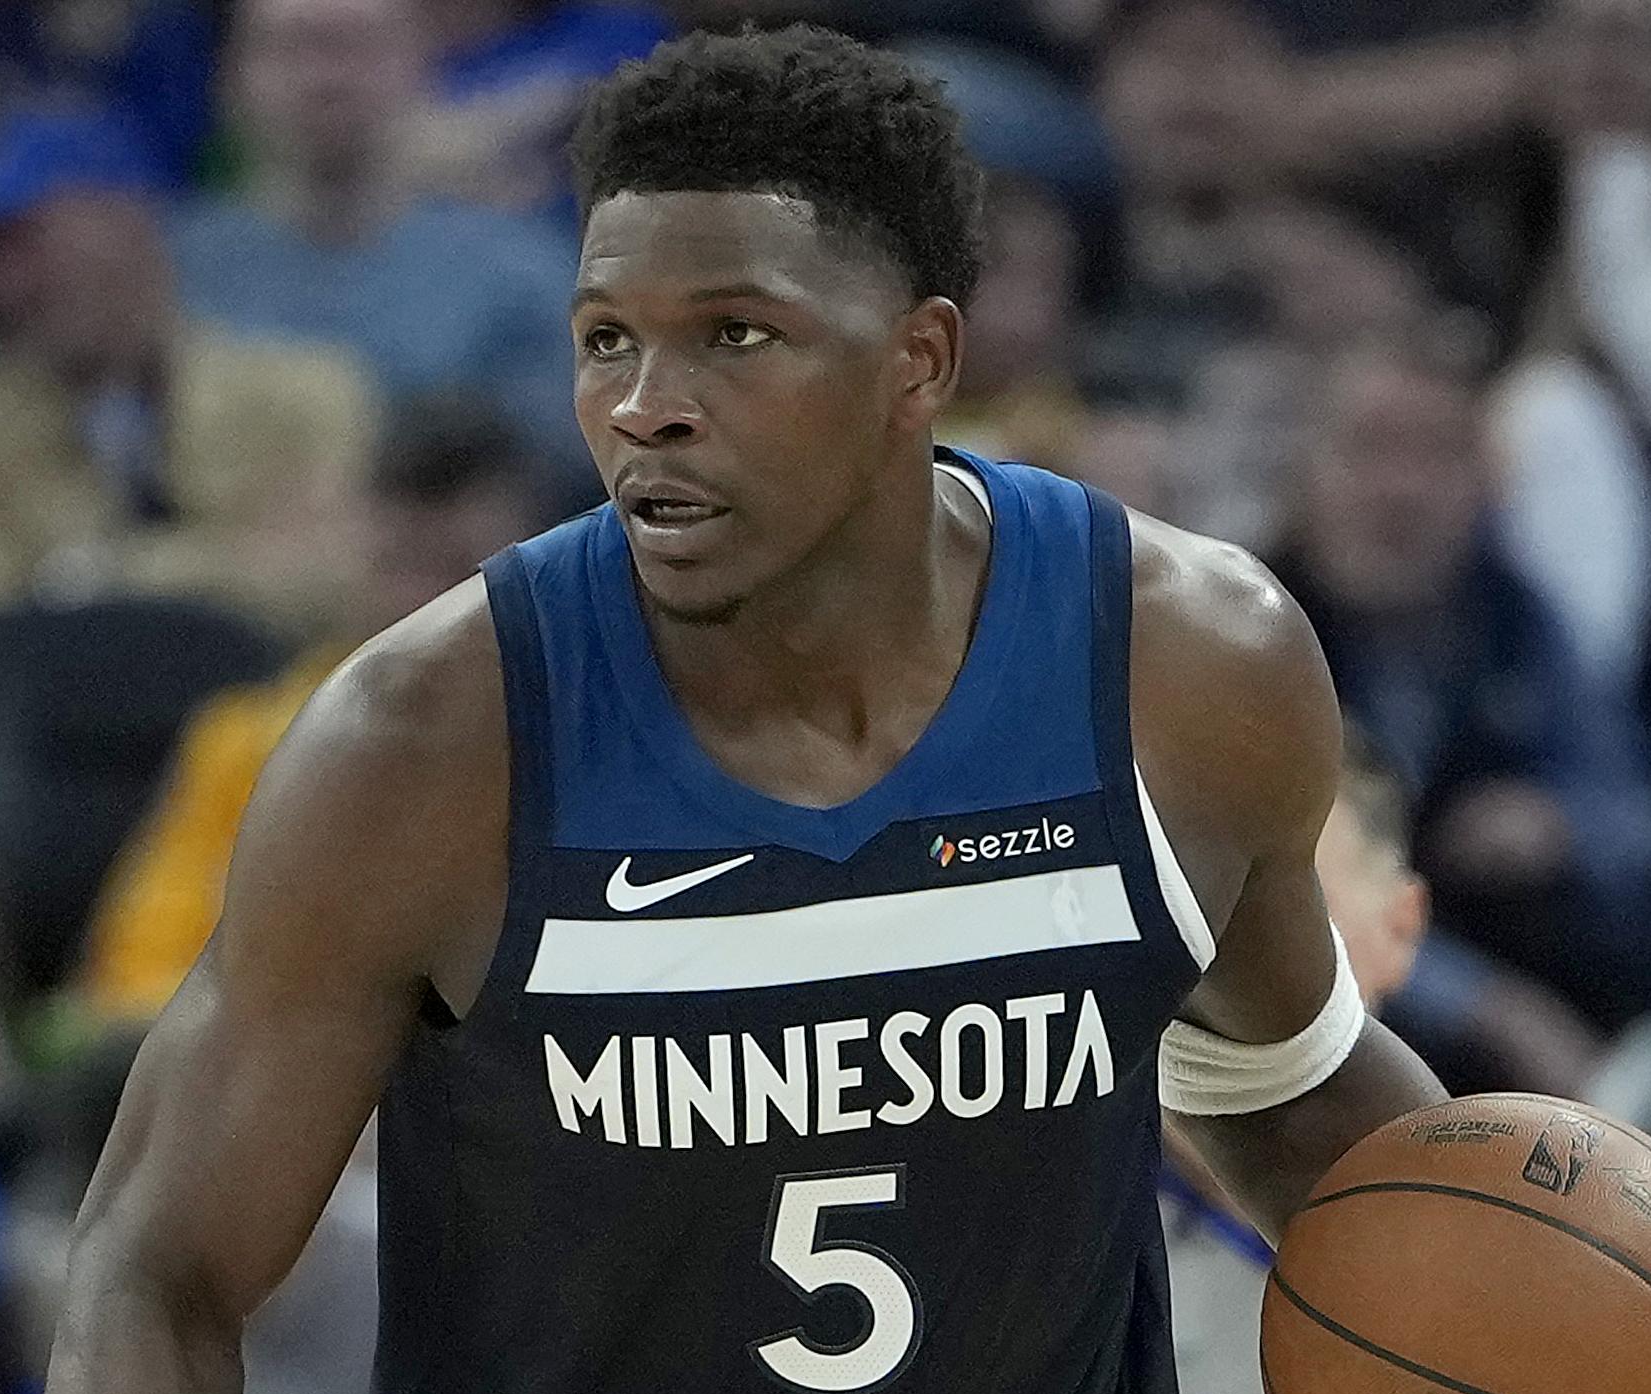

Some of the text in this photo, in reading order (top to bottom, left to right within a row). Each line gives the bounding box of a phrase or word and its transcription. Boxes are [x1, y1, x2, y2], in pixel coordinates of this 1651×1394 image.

[957, 817, 1076, 862] sezzle
[543, 989, 1114, 1149] MINNESOTA
[755, 1171, 917, 1392] 5
